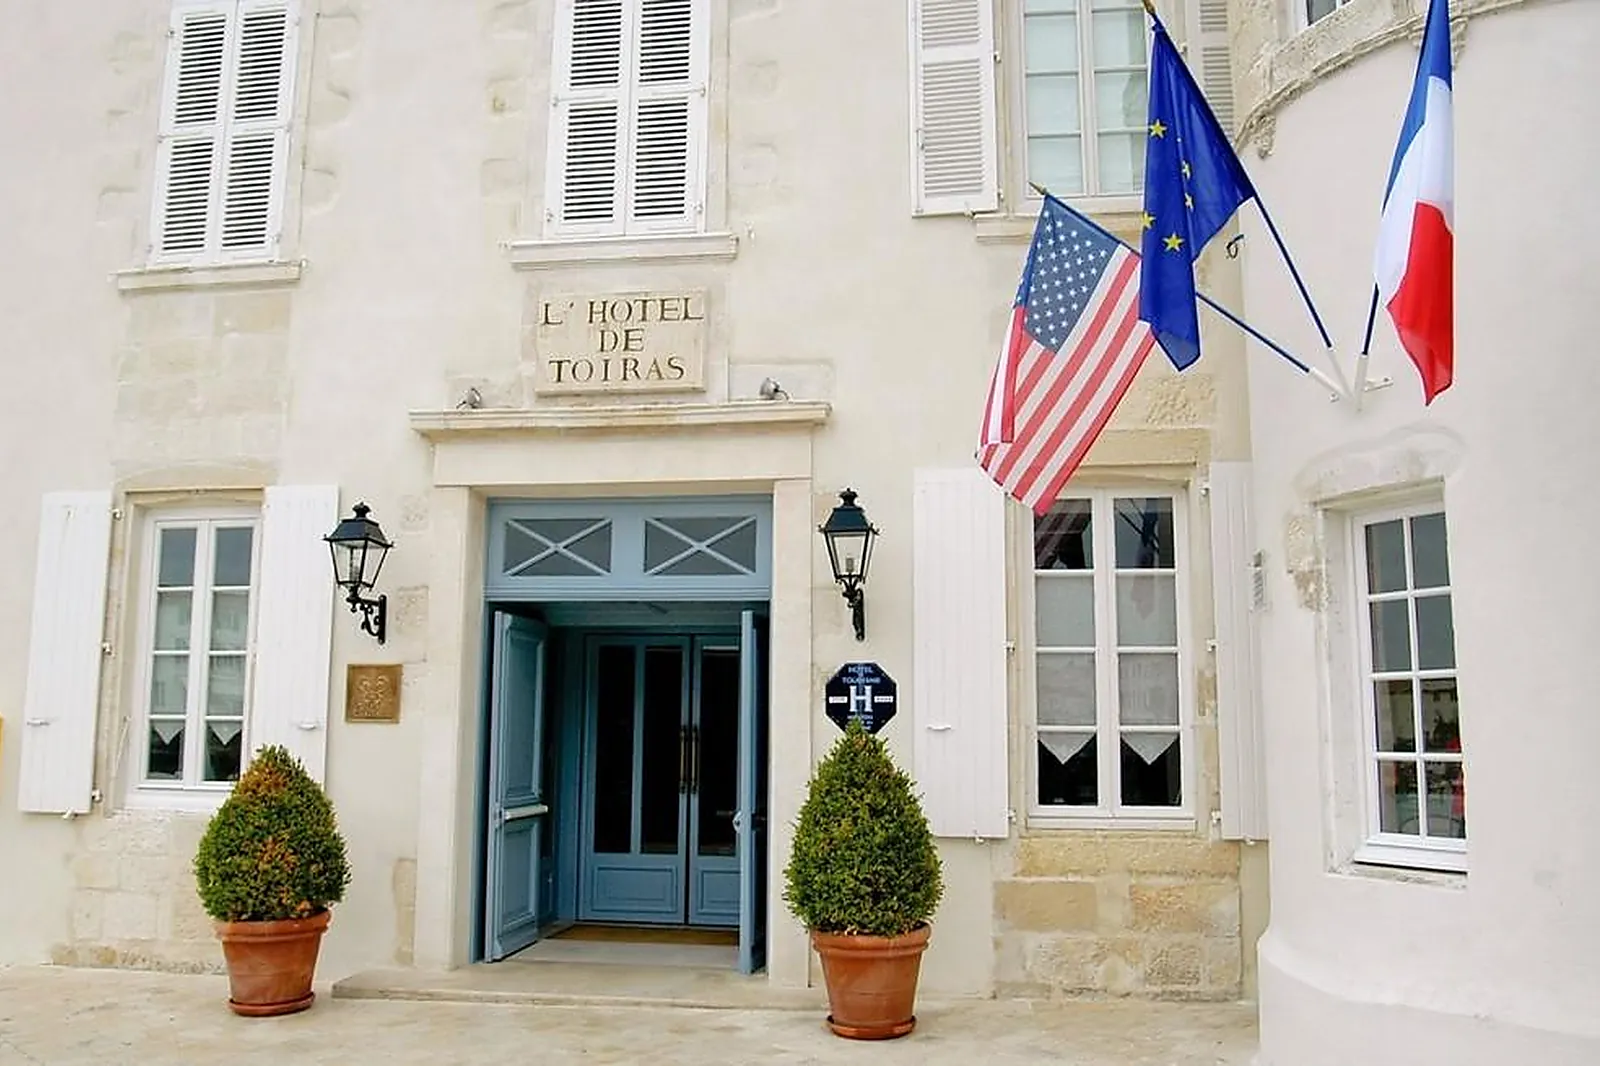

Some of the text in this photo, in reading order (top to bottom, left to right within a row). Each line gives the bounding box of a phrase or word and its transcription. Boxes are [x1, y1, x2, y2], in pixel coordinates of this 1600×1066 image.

[587, 297, 704, 324] HOTEL
[599, 328, 645, 353] DE
[549, 356, 685, 383] TOIRAS
[849, 685, 873, 712] H
